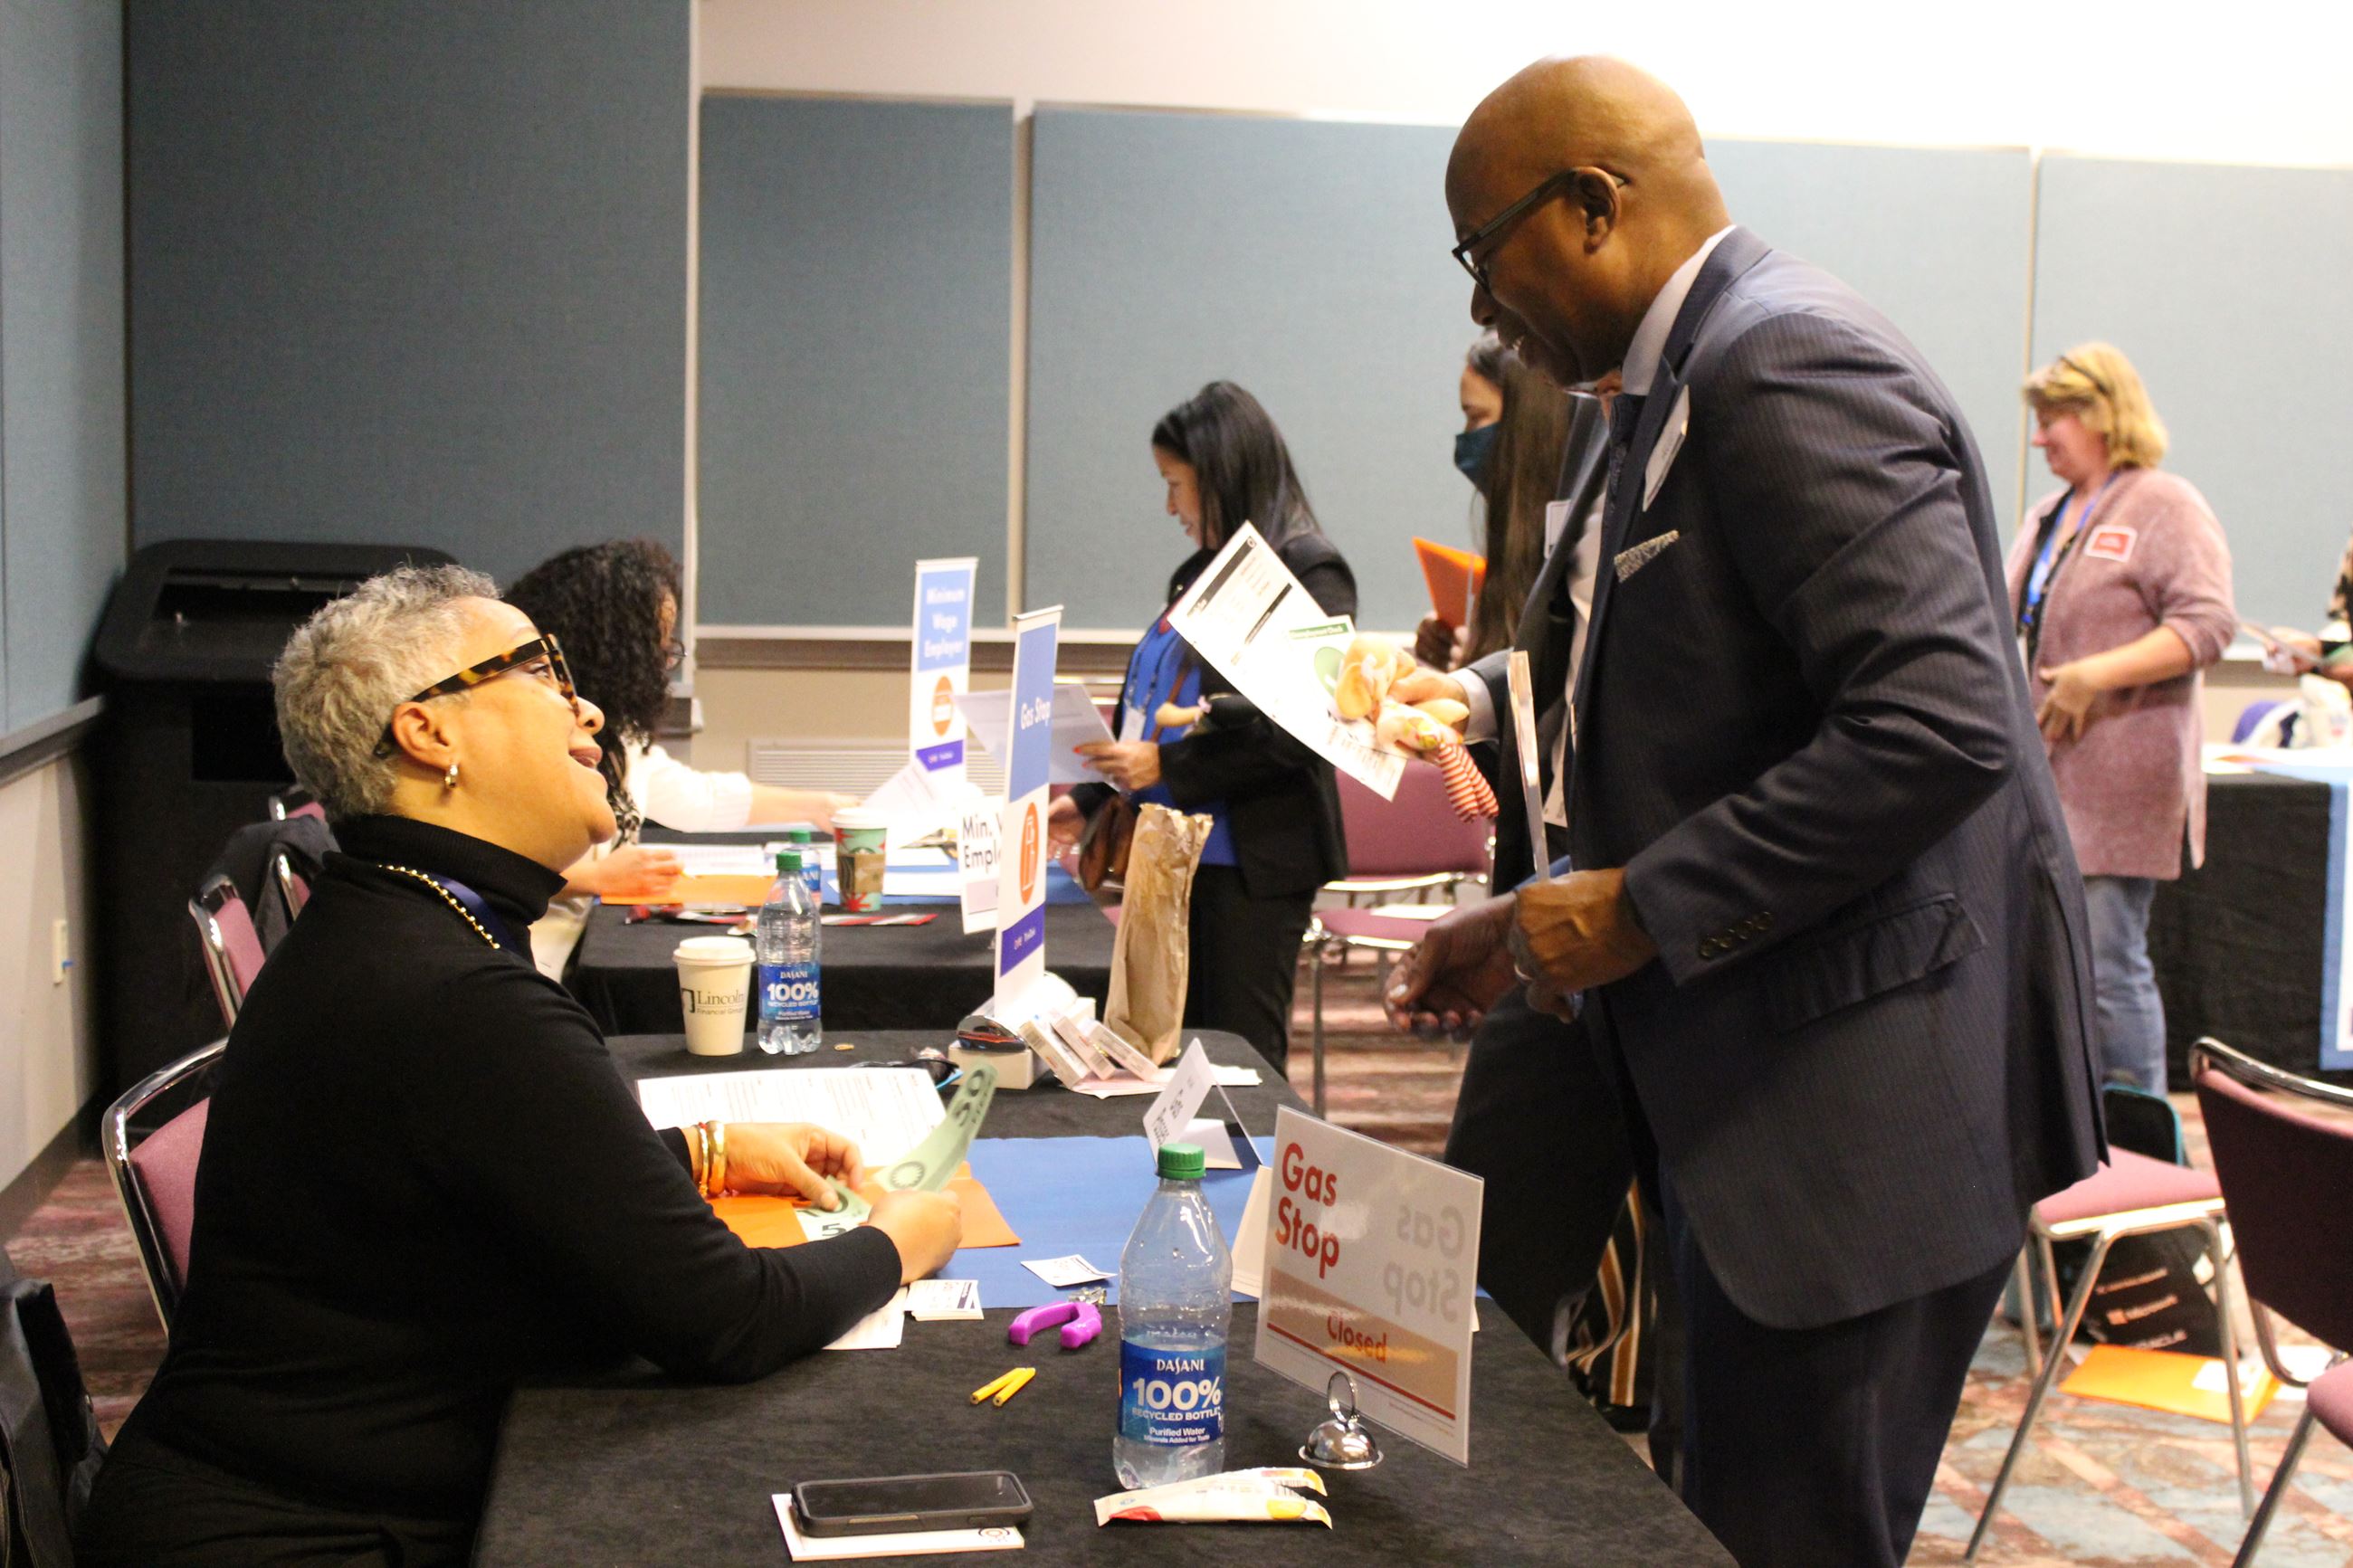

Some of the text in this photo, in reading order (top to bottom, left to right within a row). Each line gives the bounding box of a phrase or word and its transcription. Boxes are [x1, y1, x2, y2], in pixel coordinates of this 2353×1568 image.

[1021, 697, 1051, 730] Gas Stop
[962, 813, 994, 841] Min.
[964, 839, 1001, 874] Empl
[780, 971, 808, 980] DASANI
[767, 981, 819, 1002] 100%
[1281, 1142, 1338, 1207] Gas
[1275, 1196, 1340, 1279] Stop
[1327, 1314, 1387, 1364] Closed
[1157, 1357, 1205, 1374] DASANI
[1132, 1376, 1222, 1411] 100%
[1131, 1407, 1184, 1421] RECYCLED
[1149, 1427, 1206, 1437] Purified Water
